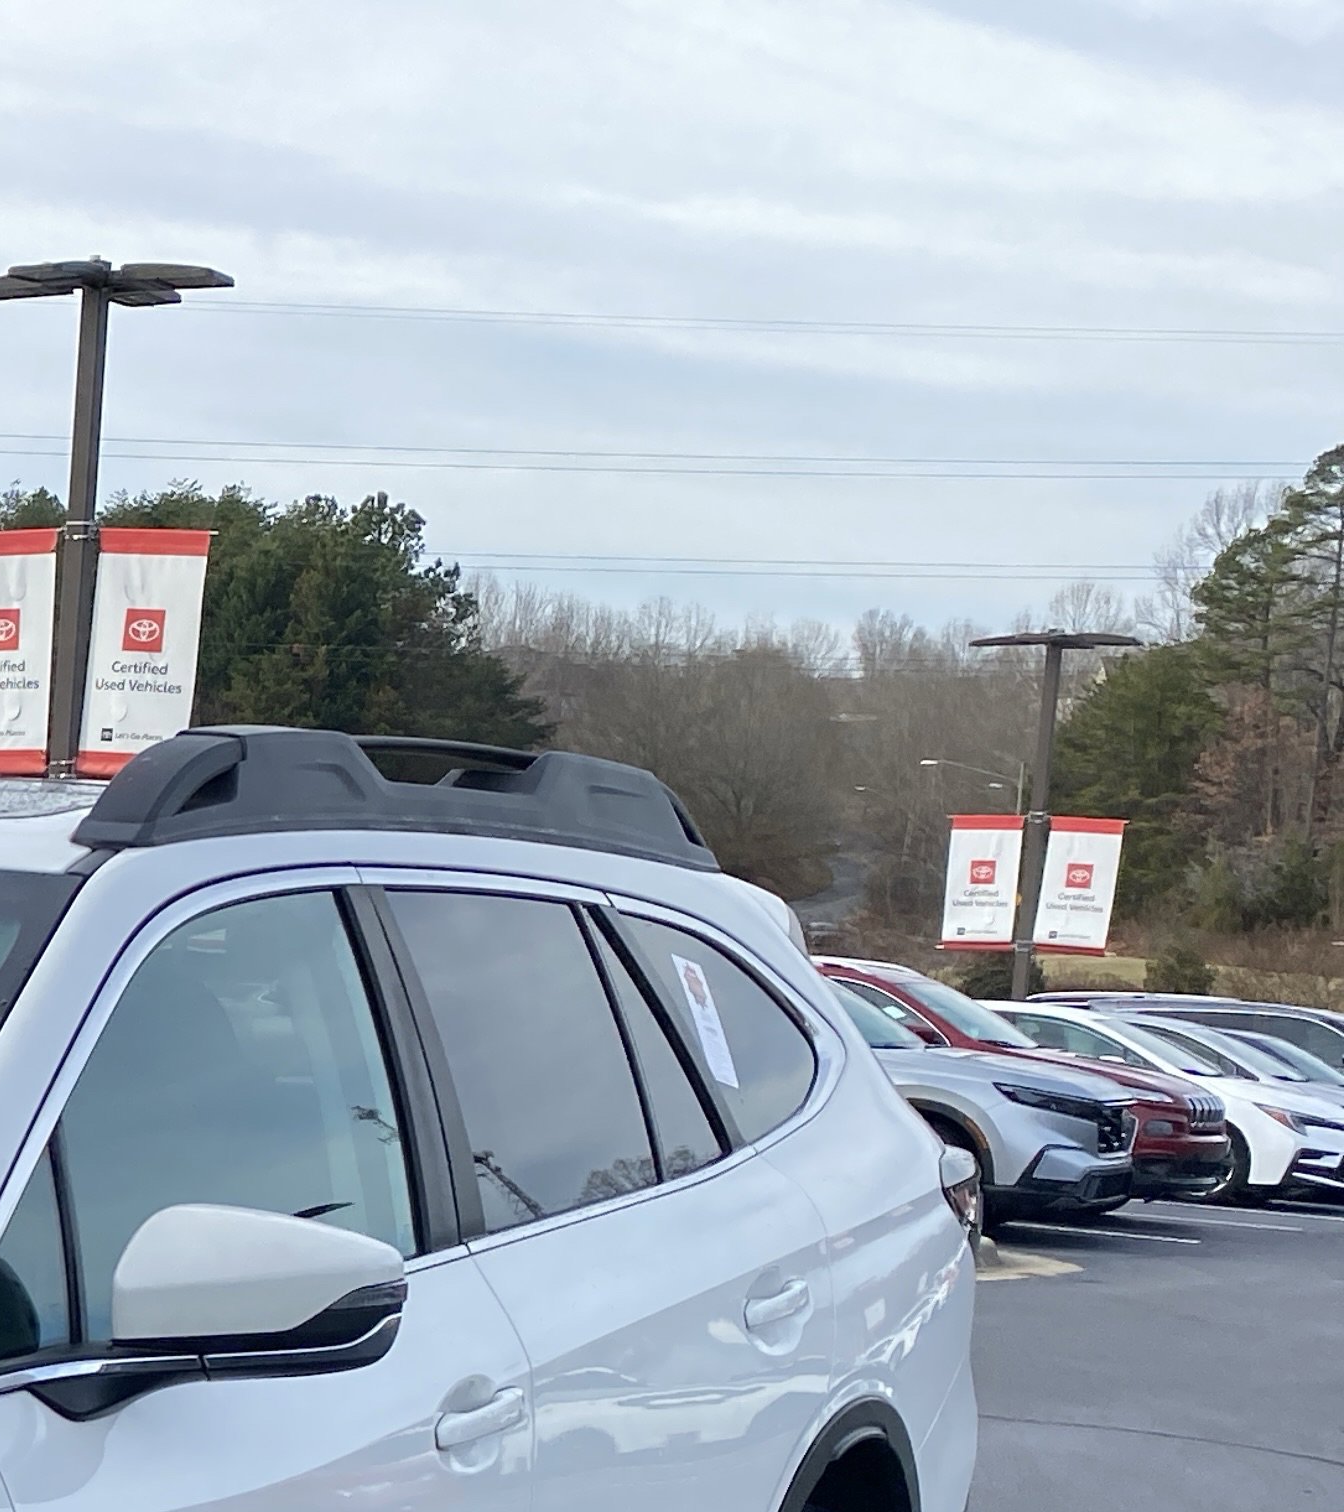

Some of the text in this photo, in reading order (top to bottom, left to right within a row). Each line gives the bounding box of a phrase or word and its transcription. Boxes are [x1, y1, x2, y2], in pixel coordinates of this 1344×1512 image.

[112, 660, 168, 675] Certified
[95, 679, 182, 694] Used Vehicles
